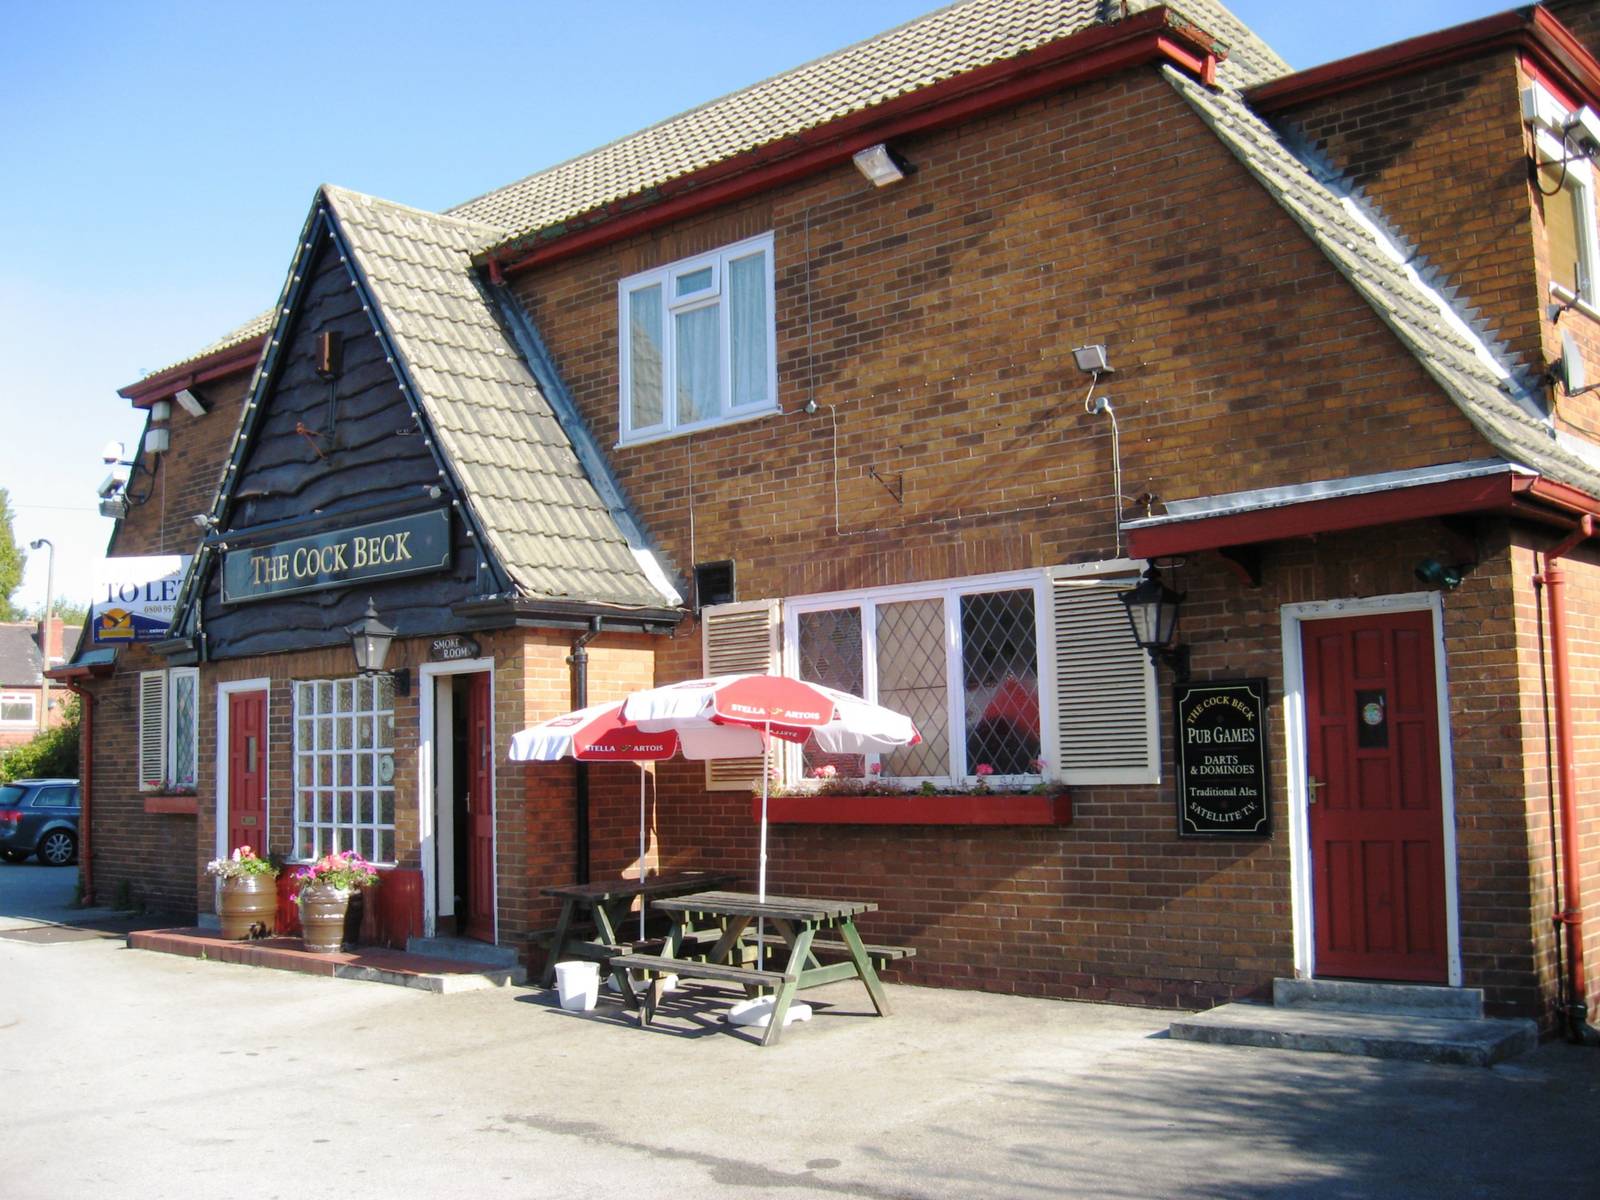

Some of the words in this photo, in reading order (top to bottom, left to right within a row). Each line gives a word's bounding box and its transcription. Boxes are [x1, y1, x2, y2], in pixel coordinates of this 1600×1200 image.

[250, 554, 290, 585] THE
[293, 542, 348, 578] COCK
[352, 531, 412, 569] BECK
[102, 581, 139, 603] TO
[433, 638, 460, 650] SMOKE
[443, 647, 468, 658] ROOM
[731, 704, 765, 715] STELLA
[784, 710, 820, 720] ARTOIS
[1186, 703, 1205, 724] THE
[1203, 696, 1230, 708] COCK
[1231, 698, 1255, 721] BECK
[1187, 727, 1211, 744] PUB
[1213, 726, 1255, 744] GAMES
[585, 744, 616, 752] STELLA
[632, 744, 664, 752] ARTOIS
[1204, 755, 1239, 765] DARTS
[1190, 766, 1198, 775] &
[1199, 764, 1255, 775] DOMINOES
[1190, 787, 1237, 797] Traditional
[1238, 787, 1257, 796] Ales
[1190, 801, 1242, 822] SATELLITE
